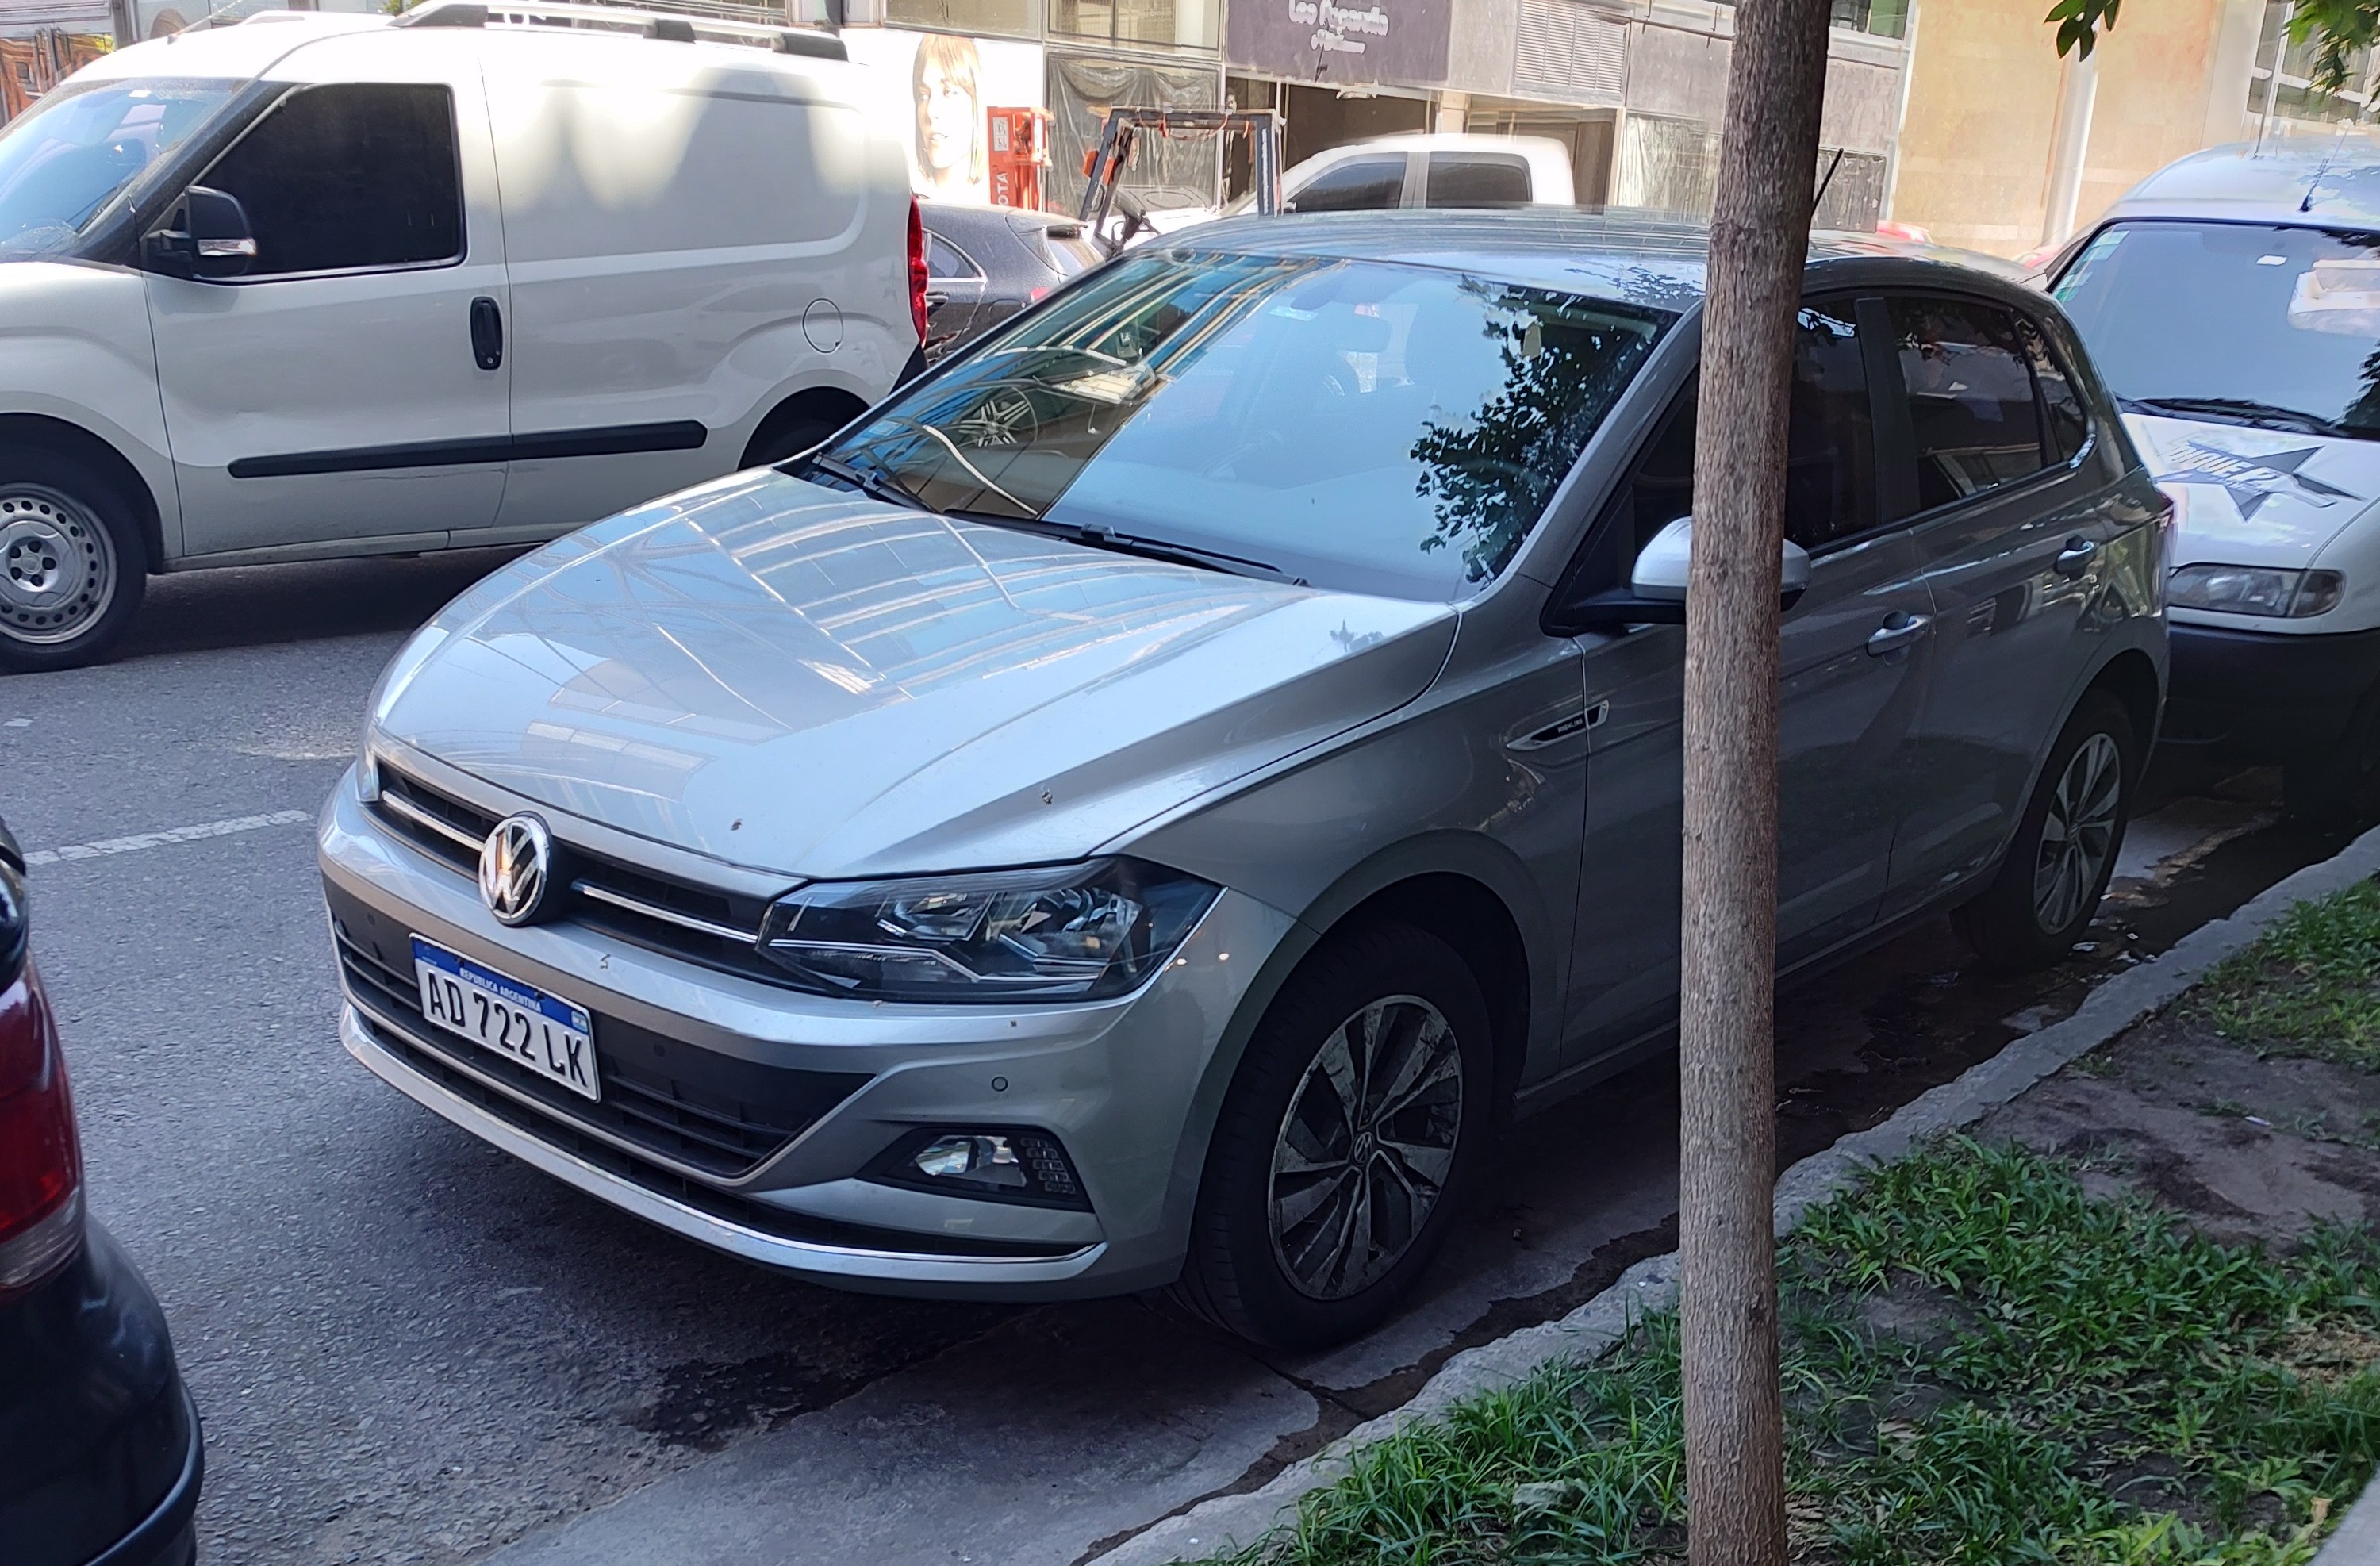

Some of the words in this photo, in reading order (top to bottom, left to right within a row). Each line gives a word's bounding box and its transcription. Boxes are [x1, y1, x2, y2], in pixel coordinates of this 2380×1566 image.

[427, 969, 466, 1028] AD
[472, 988, 537, 1062] 722
[543, 1020, 589, 1088] LK
[499, 985, 543, 1014] ARGENTINA
